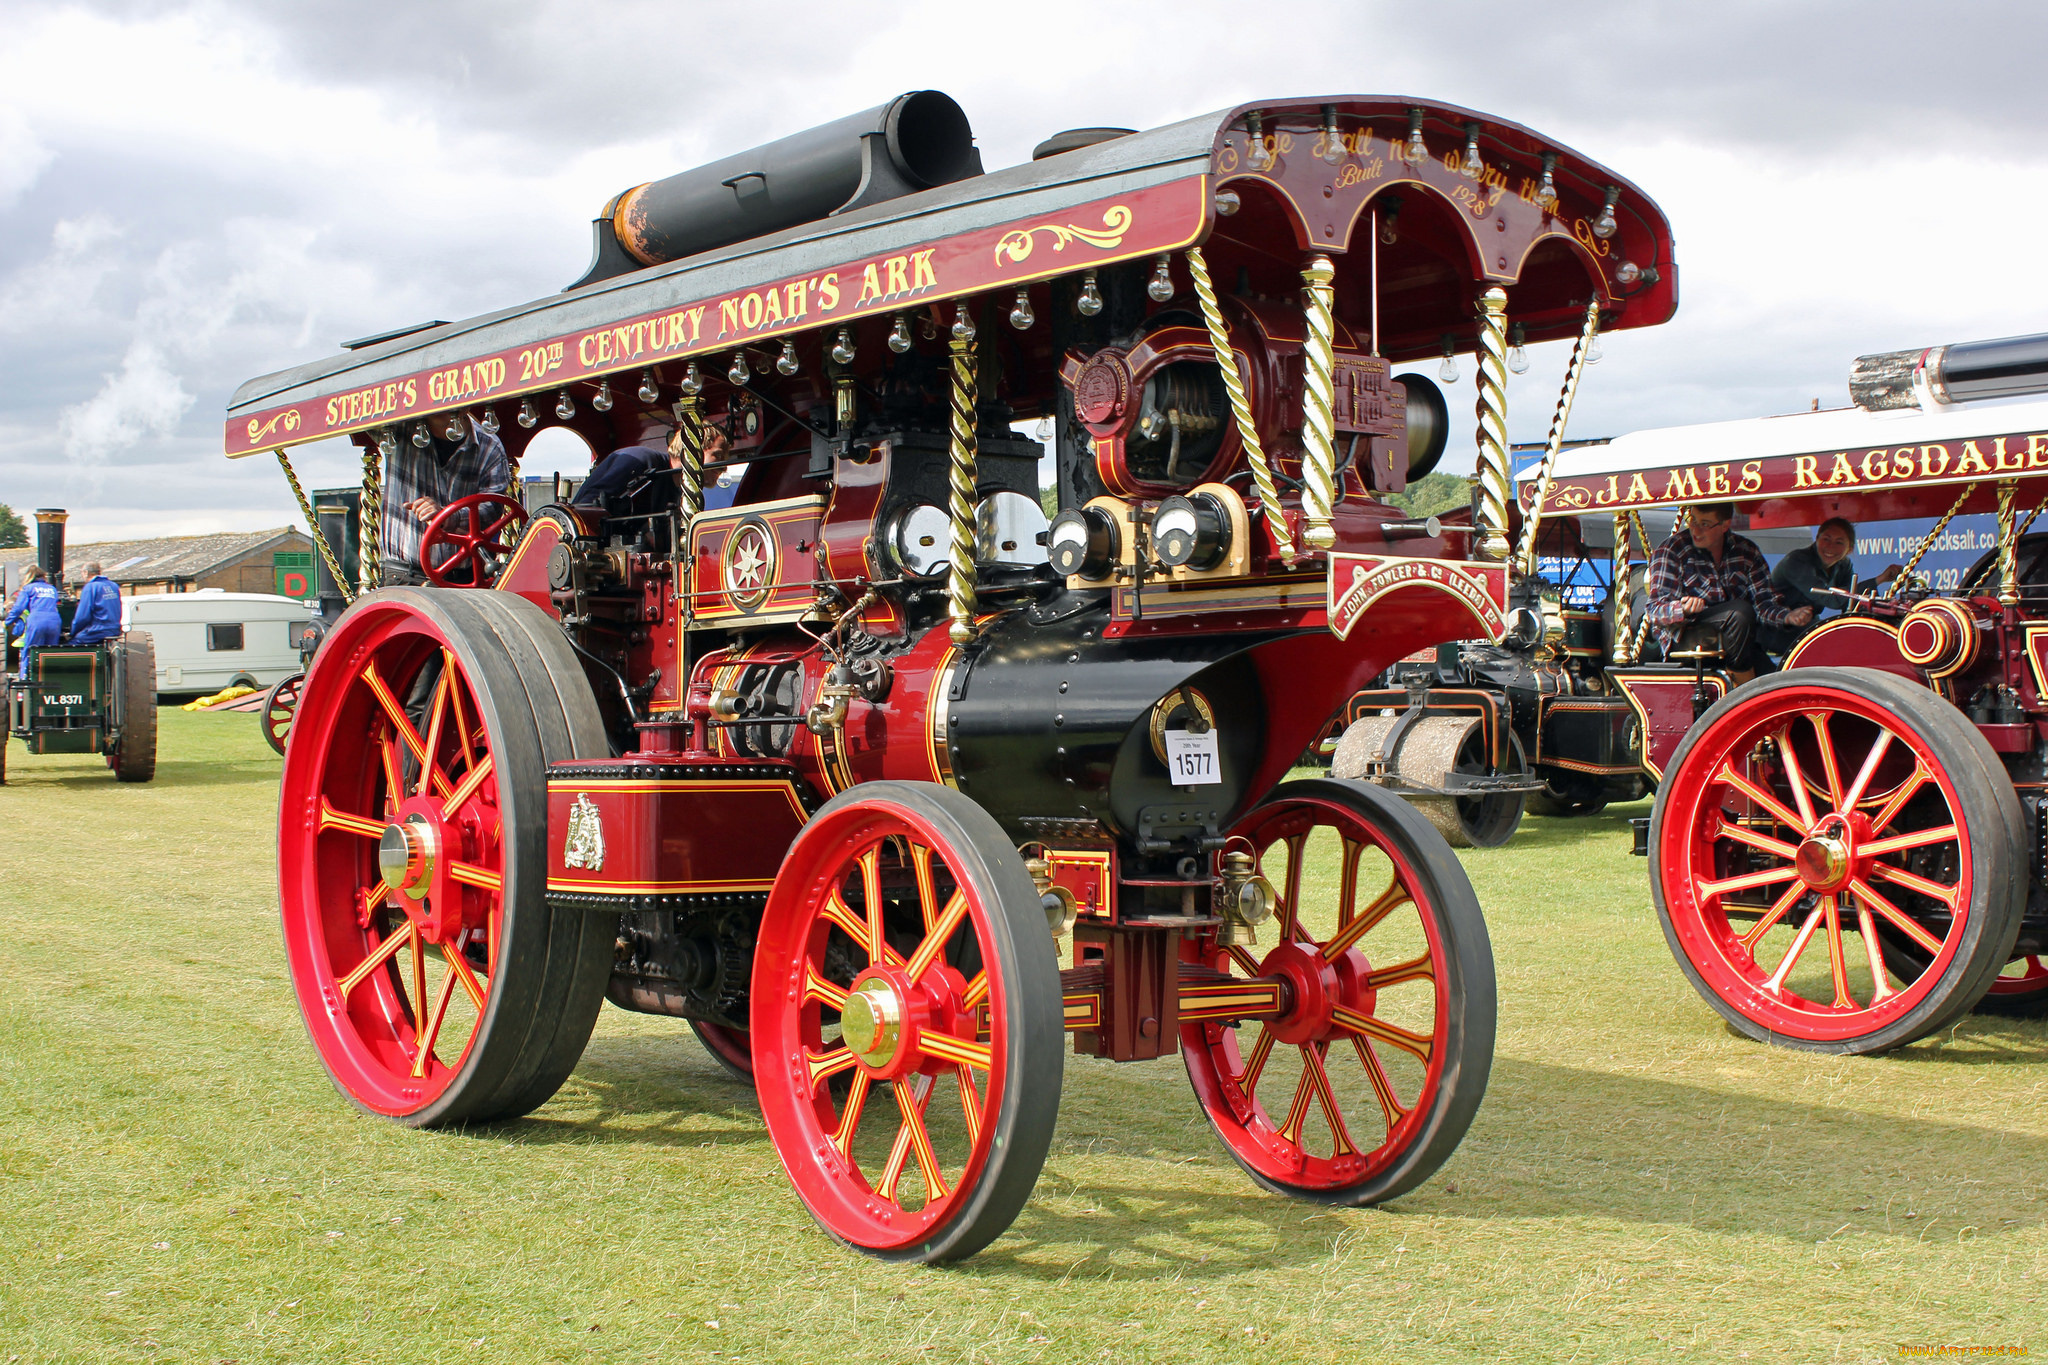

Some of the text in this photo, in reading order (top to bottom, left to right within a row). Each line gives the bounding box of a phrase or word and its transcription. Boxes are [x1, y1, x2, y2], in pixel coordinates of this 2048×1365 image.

[1244, 131, 1296, 173] ge
[1310, 127, 1376, 158] sall
[1389, 137, 1428, 164] no
[1335, 157, 1486, 216] Built 1928
[326, 378, 418, 427] STEELE'S
[429, 357, 506, 404] GRAND
[578, 305, 706, 368] CENTURY
[717, 272, 841, 340] NOAH'S
[855, 248, 939, 309] ARK
[1596, 433, 2048, 505] JAMES RAGSDALE
[1856, 528, 1999, 558] www.peaocksalt.co.
[284, 573, 308, 596] D
[1343, 587, 1369, 620] JOHN
[1370, 565, 1413, 590] FOWLER
[1417, 564, 1427, 577] &
[1449, 572, 1486, 610] (LEEDS)
[1935, 567, 1960, 591] 292
[42, 694, 83, 705] VL 8371
[1176, 753, 1212, 776] 1577
